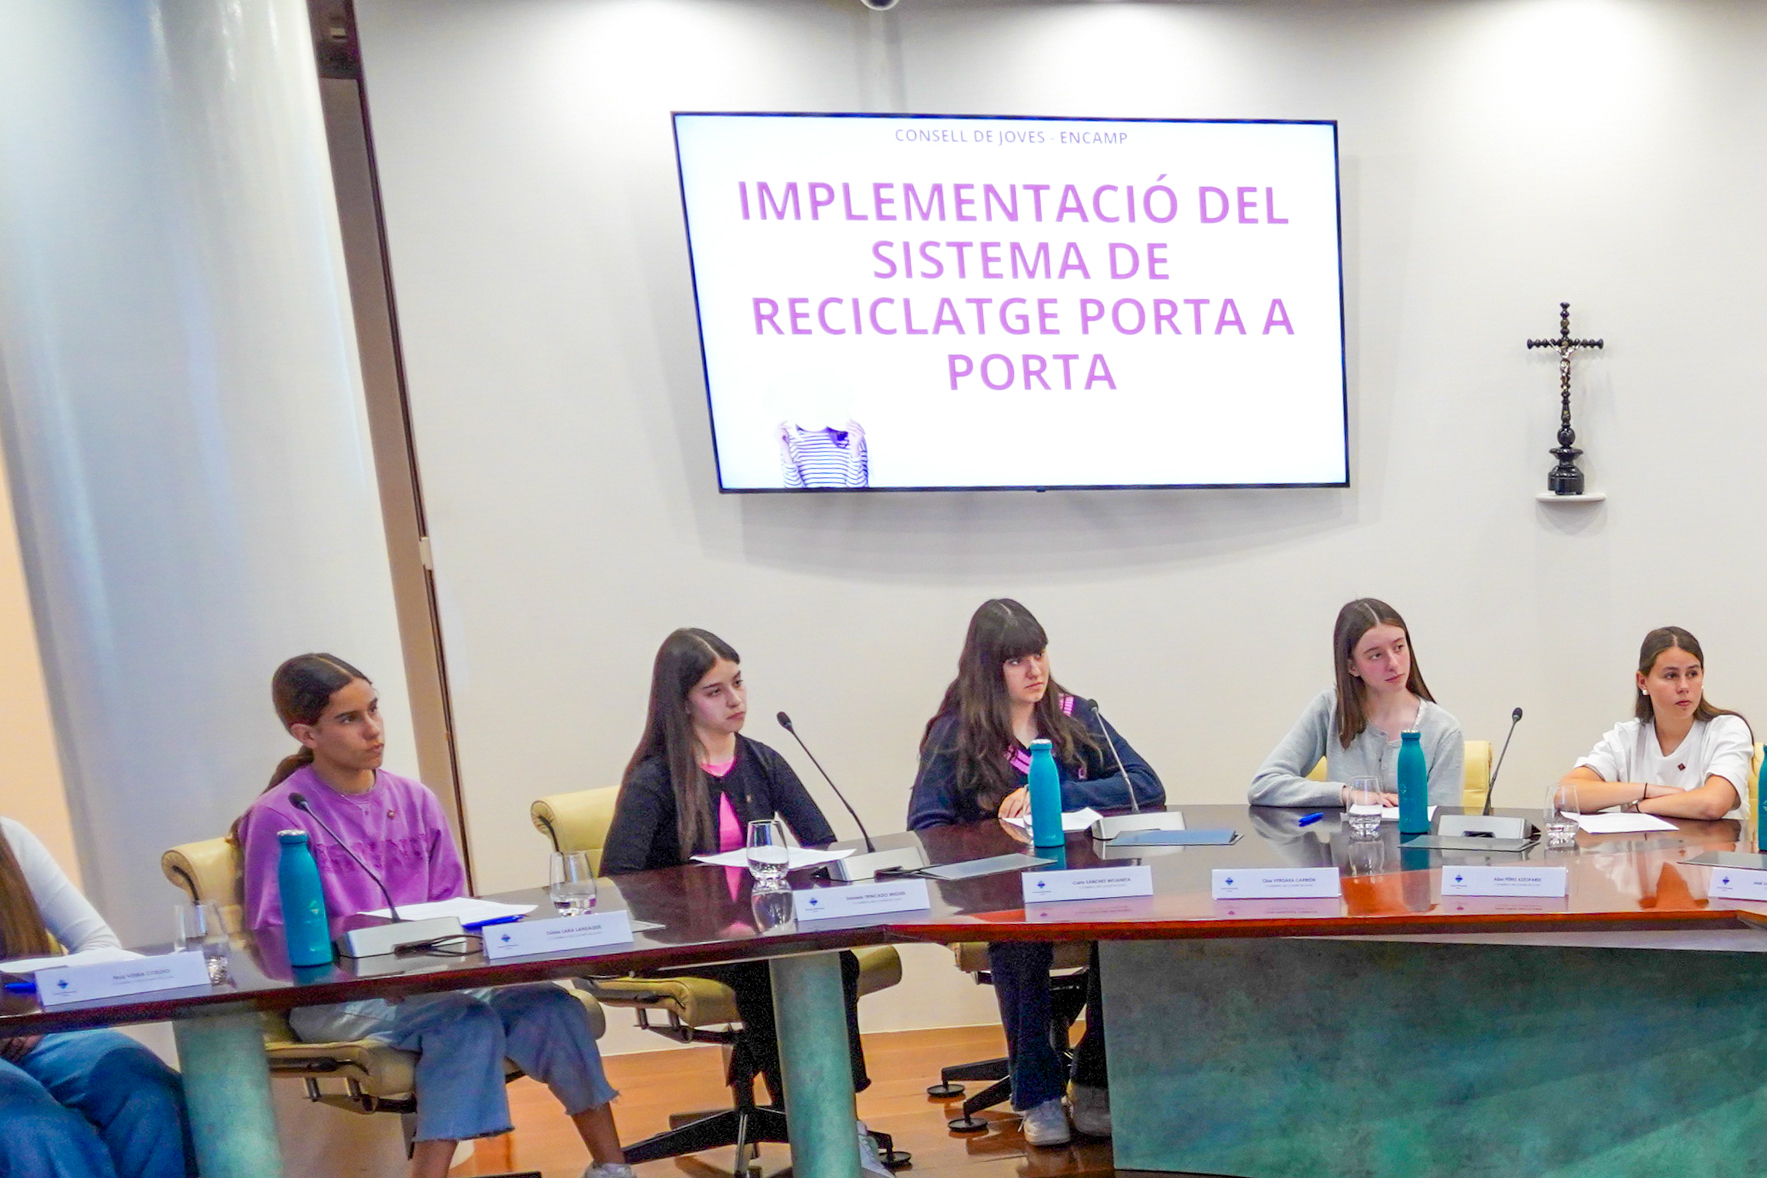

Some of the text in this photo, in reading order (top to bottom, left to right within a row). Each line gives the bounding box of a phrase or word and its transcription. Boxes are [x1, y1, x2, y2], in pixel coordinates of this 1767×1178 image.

[895, 128, 968, 143] CONSELL
[973, 129, 994, 143] DE
[998, 130, 1046, 147] JOVES
[1059, 130, 1128, 145] ENCAMP
[737, 173, 1290, 225] IMPLEMENTACIÓ DEL
[871, 239, 1170, 281] SISTEMA DE
[751, 296, 1295, 336] RECICLATGE PORTA A
[947, 353, 1118, 391] PORTA
